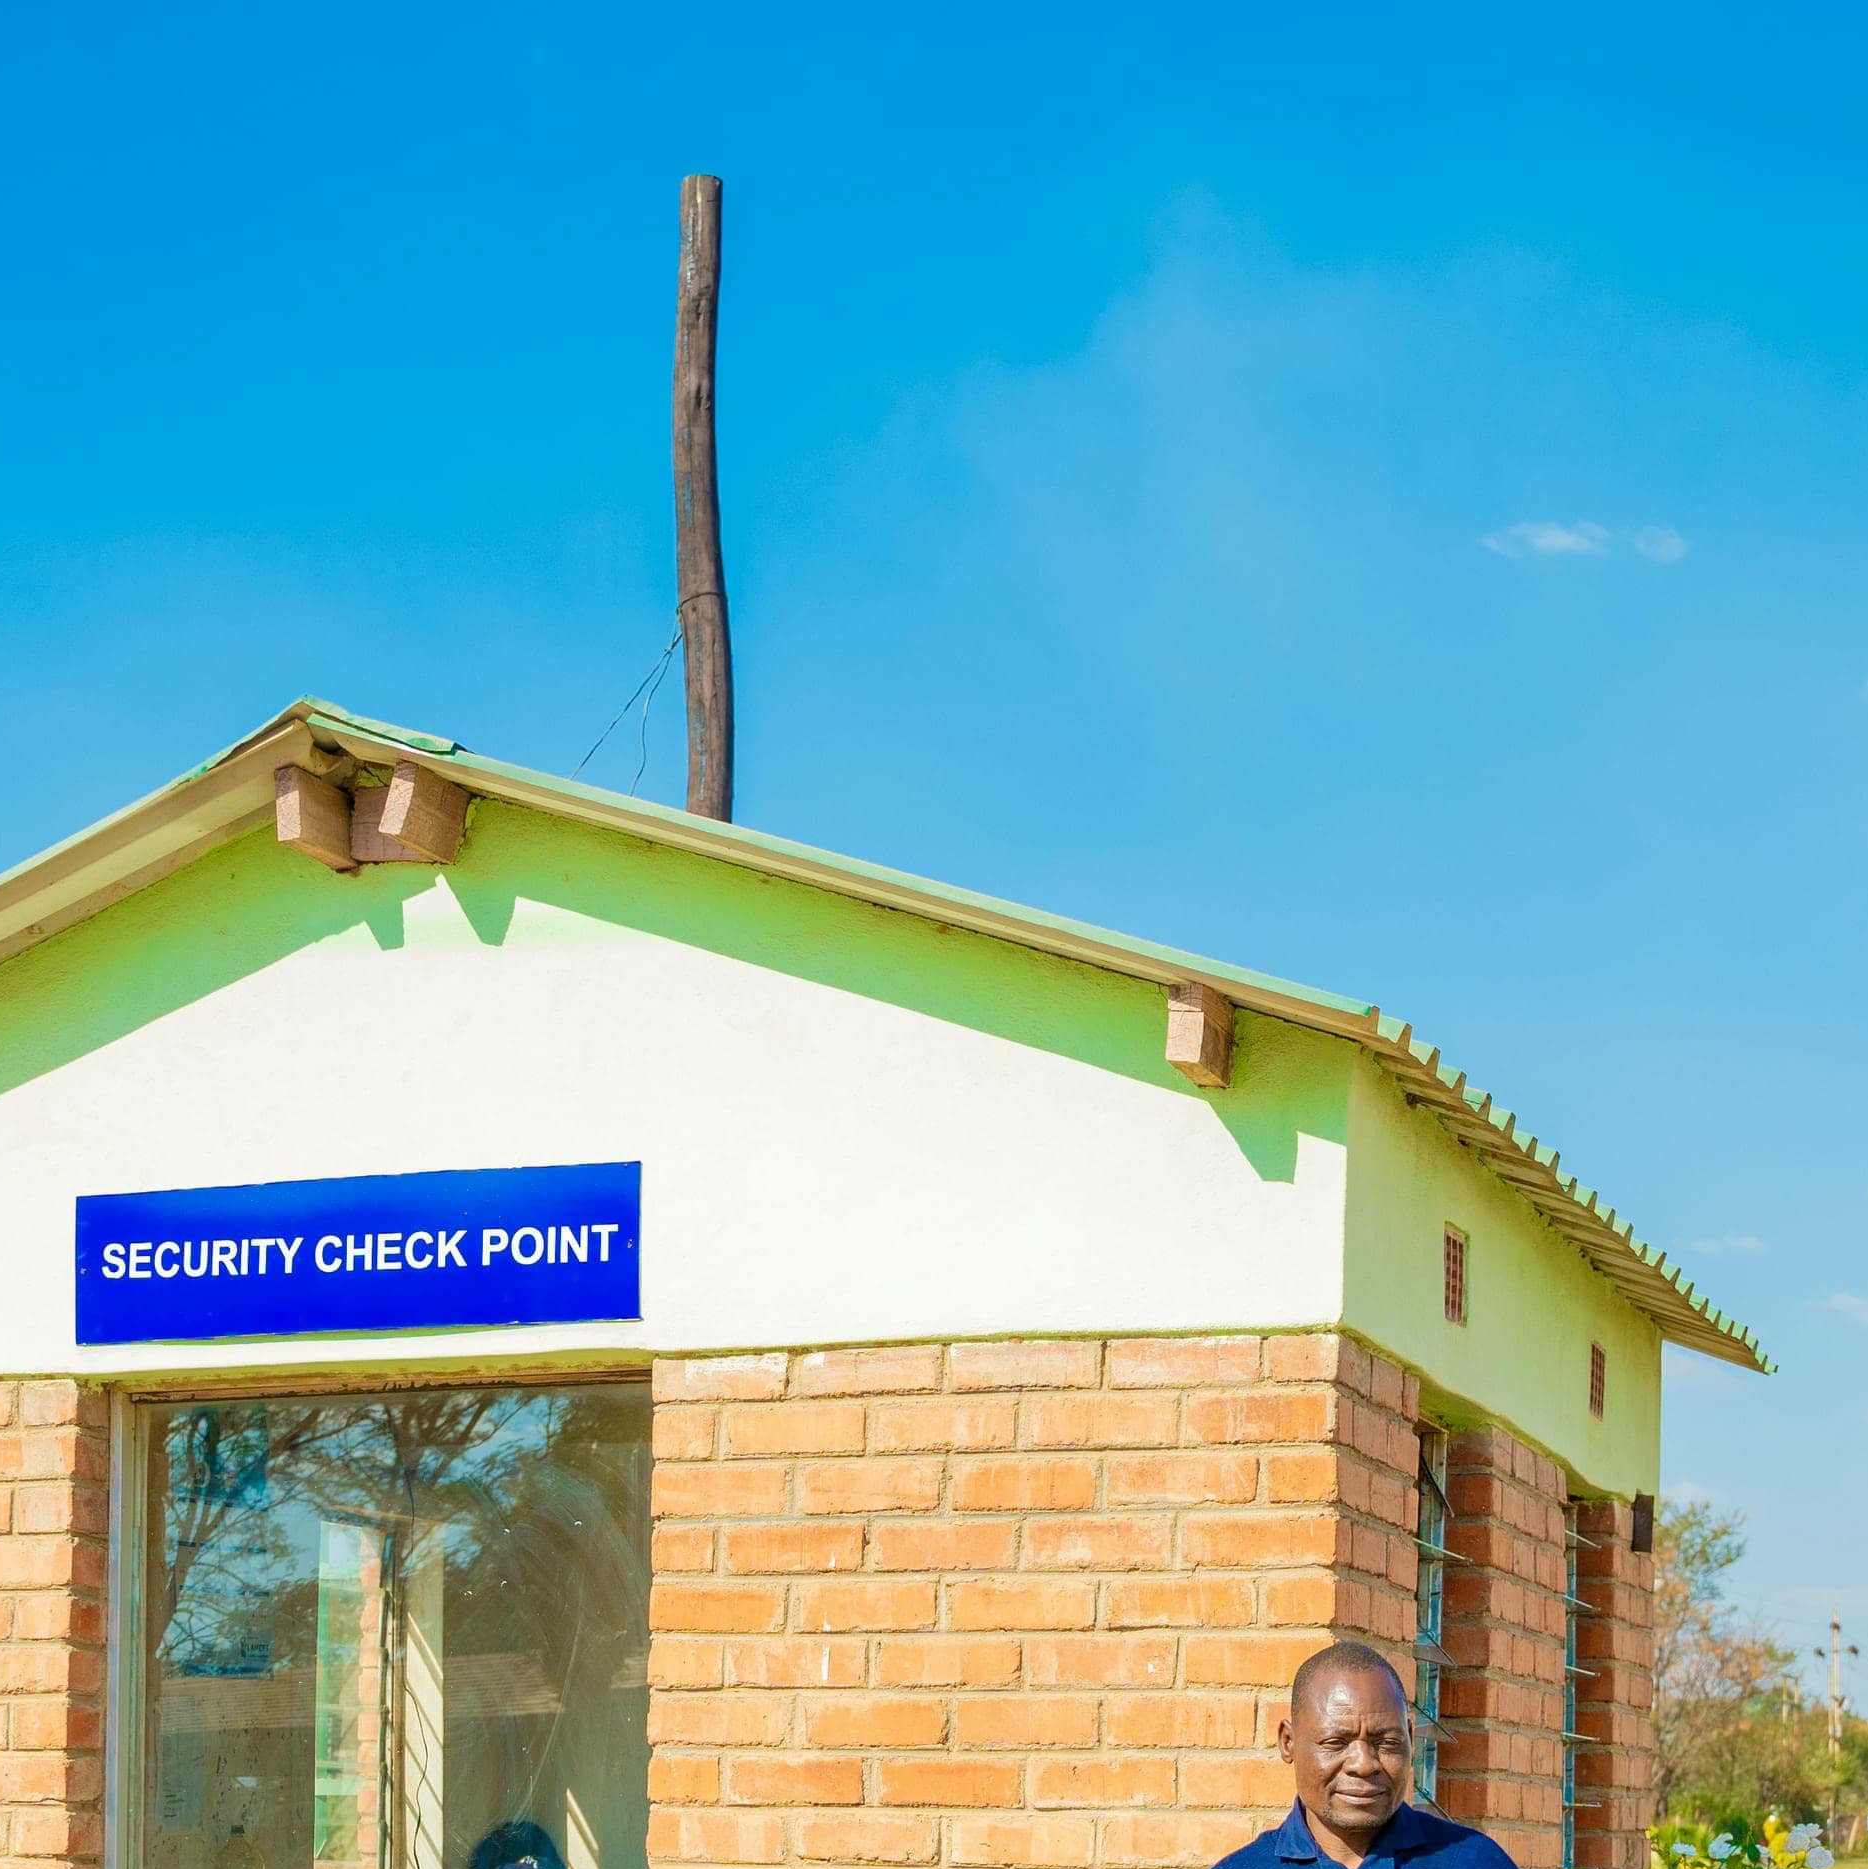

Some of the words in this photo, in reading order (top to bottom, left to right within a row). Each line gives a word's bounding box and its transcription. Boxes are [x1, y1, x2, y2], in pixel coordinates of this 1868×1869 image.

[101, 1237, 304, 1279] SECURITY
[314, 1230, 468, 1273] CHECK
[482, 1223, 619, 1268] POINT
